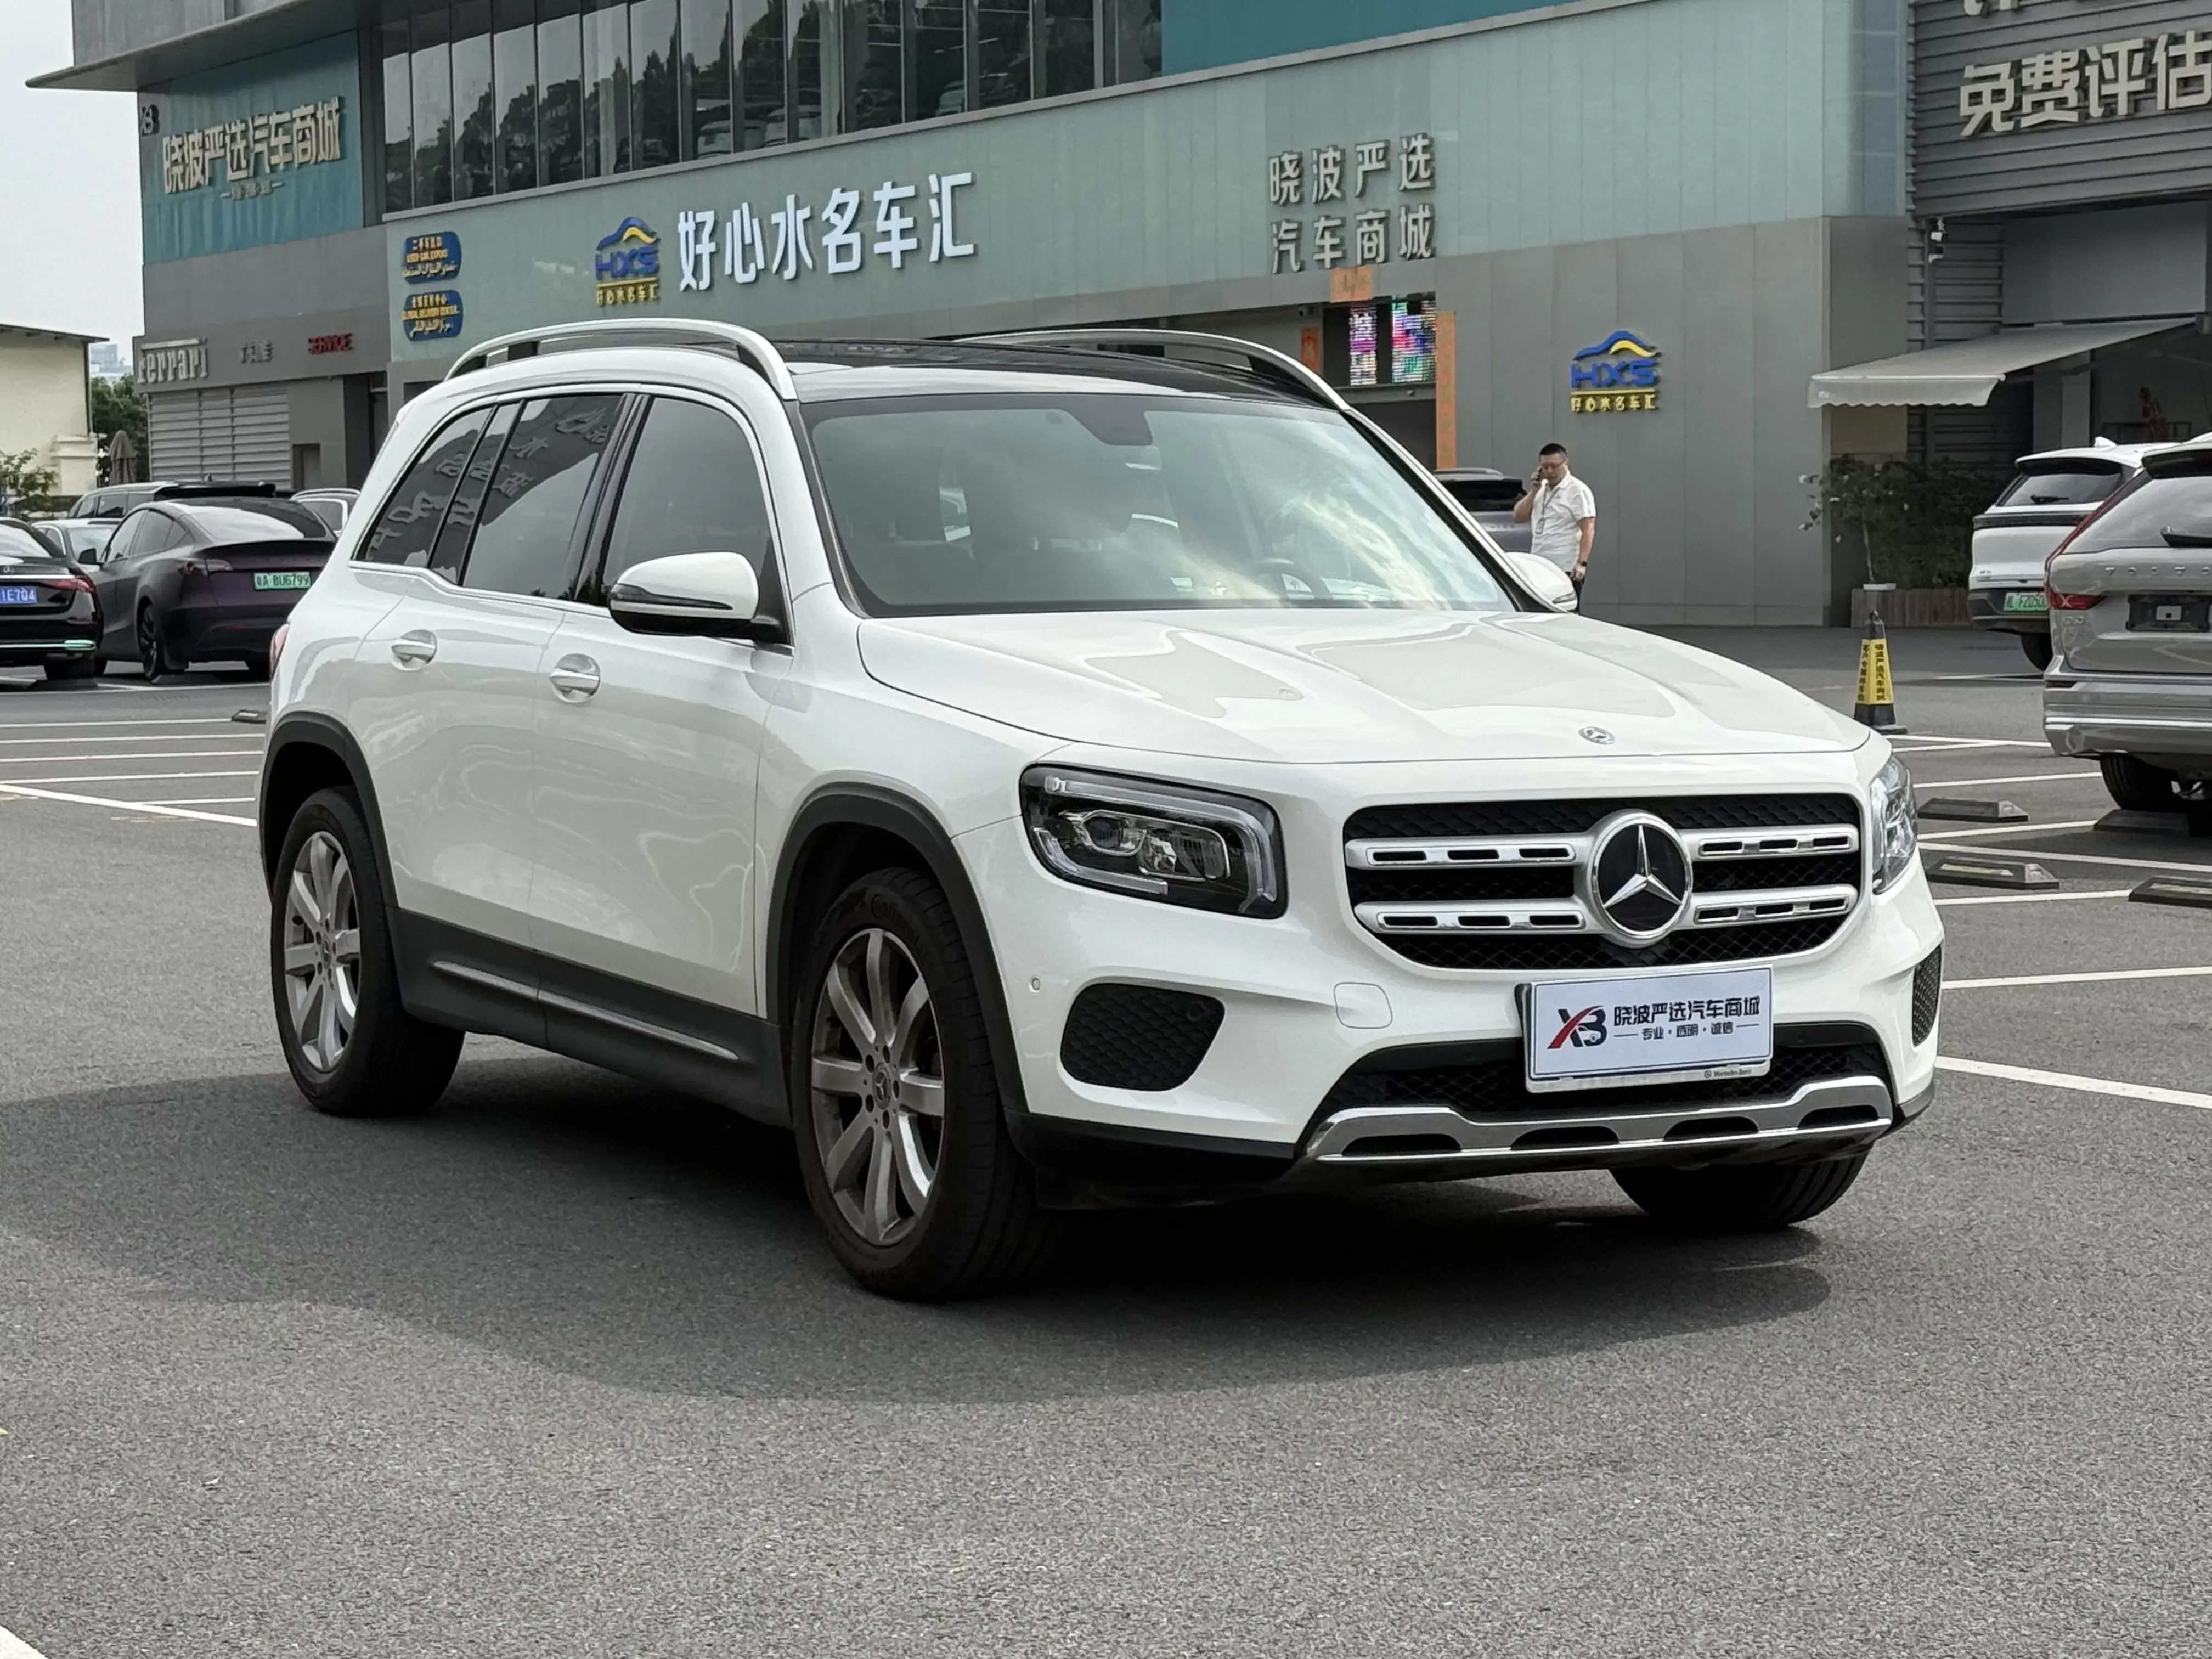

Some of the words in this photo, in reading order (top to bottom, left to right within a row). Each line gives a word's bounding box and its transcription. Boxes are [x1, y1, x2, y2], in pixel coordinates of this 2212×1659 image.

[1960, 30, 2212, 137] 免费评估
[163, 96, 345, 194] 晓波严选汽车商城
[1269, 134, 1431, 206] 晓波严选
[678, 172, 975, 291] 好心水名车汇
[1271, 204, 1432, 274] 汽车商城
[1571, 359, 1656, 387] HXS
[1613, 996, 1760, 1026] 晓波严选汽车商城
